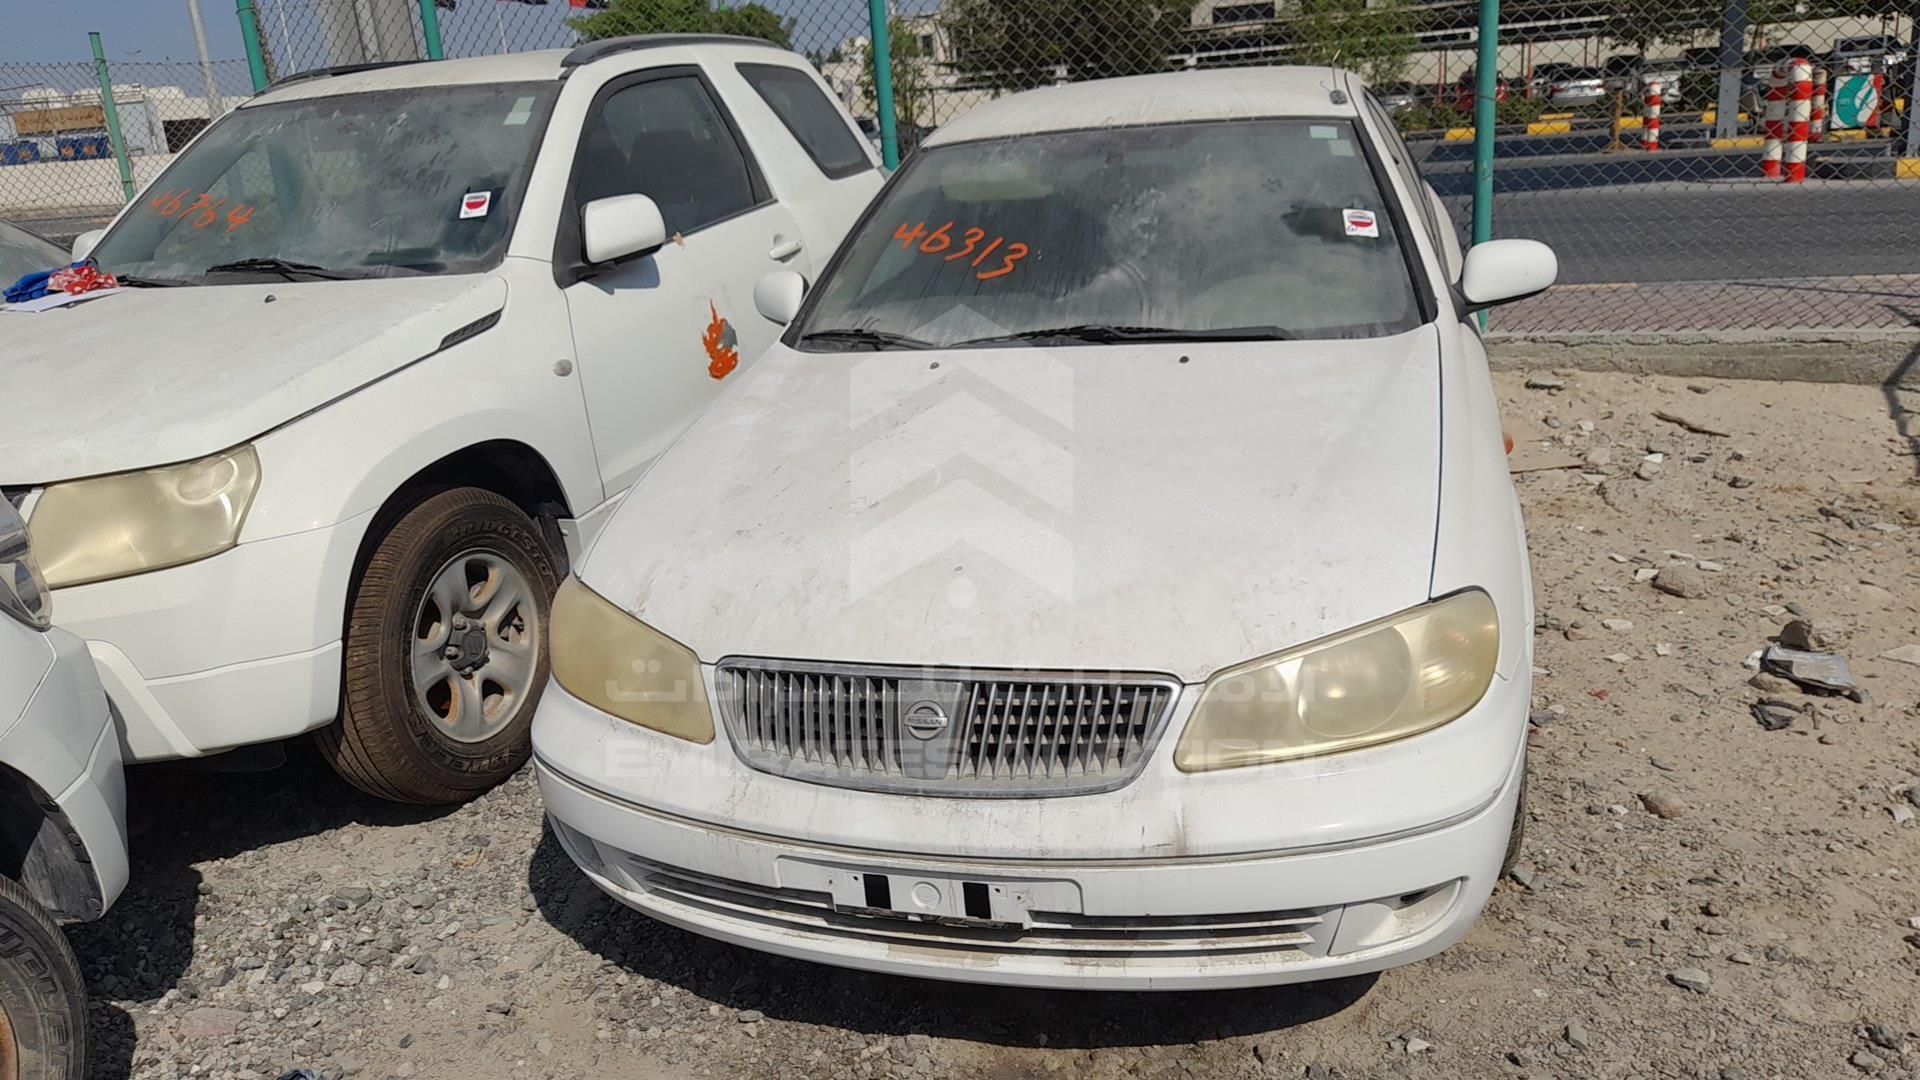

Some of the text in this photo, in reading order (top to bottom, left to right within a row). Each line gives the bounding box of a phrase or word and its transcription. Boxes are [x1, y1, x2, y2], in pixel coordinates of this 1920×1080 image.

[149, 188, 255, 233] 46764
[893, 221, 1030, 281] 46313
[907, 716, 943, 726] NISSAN
